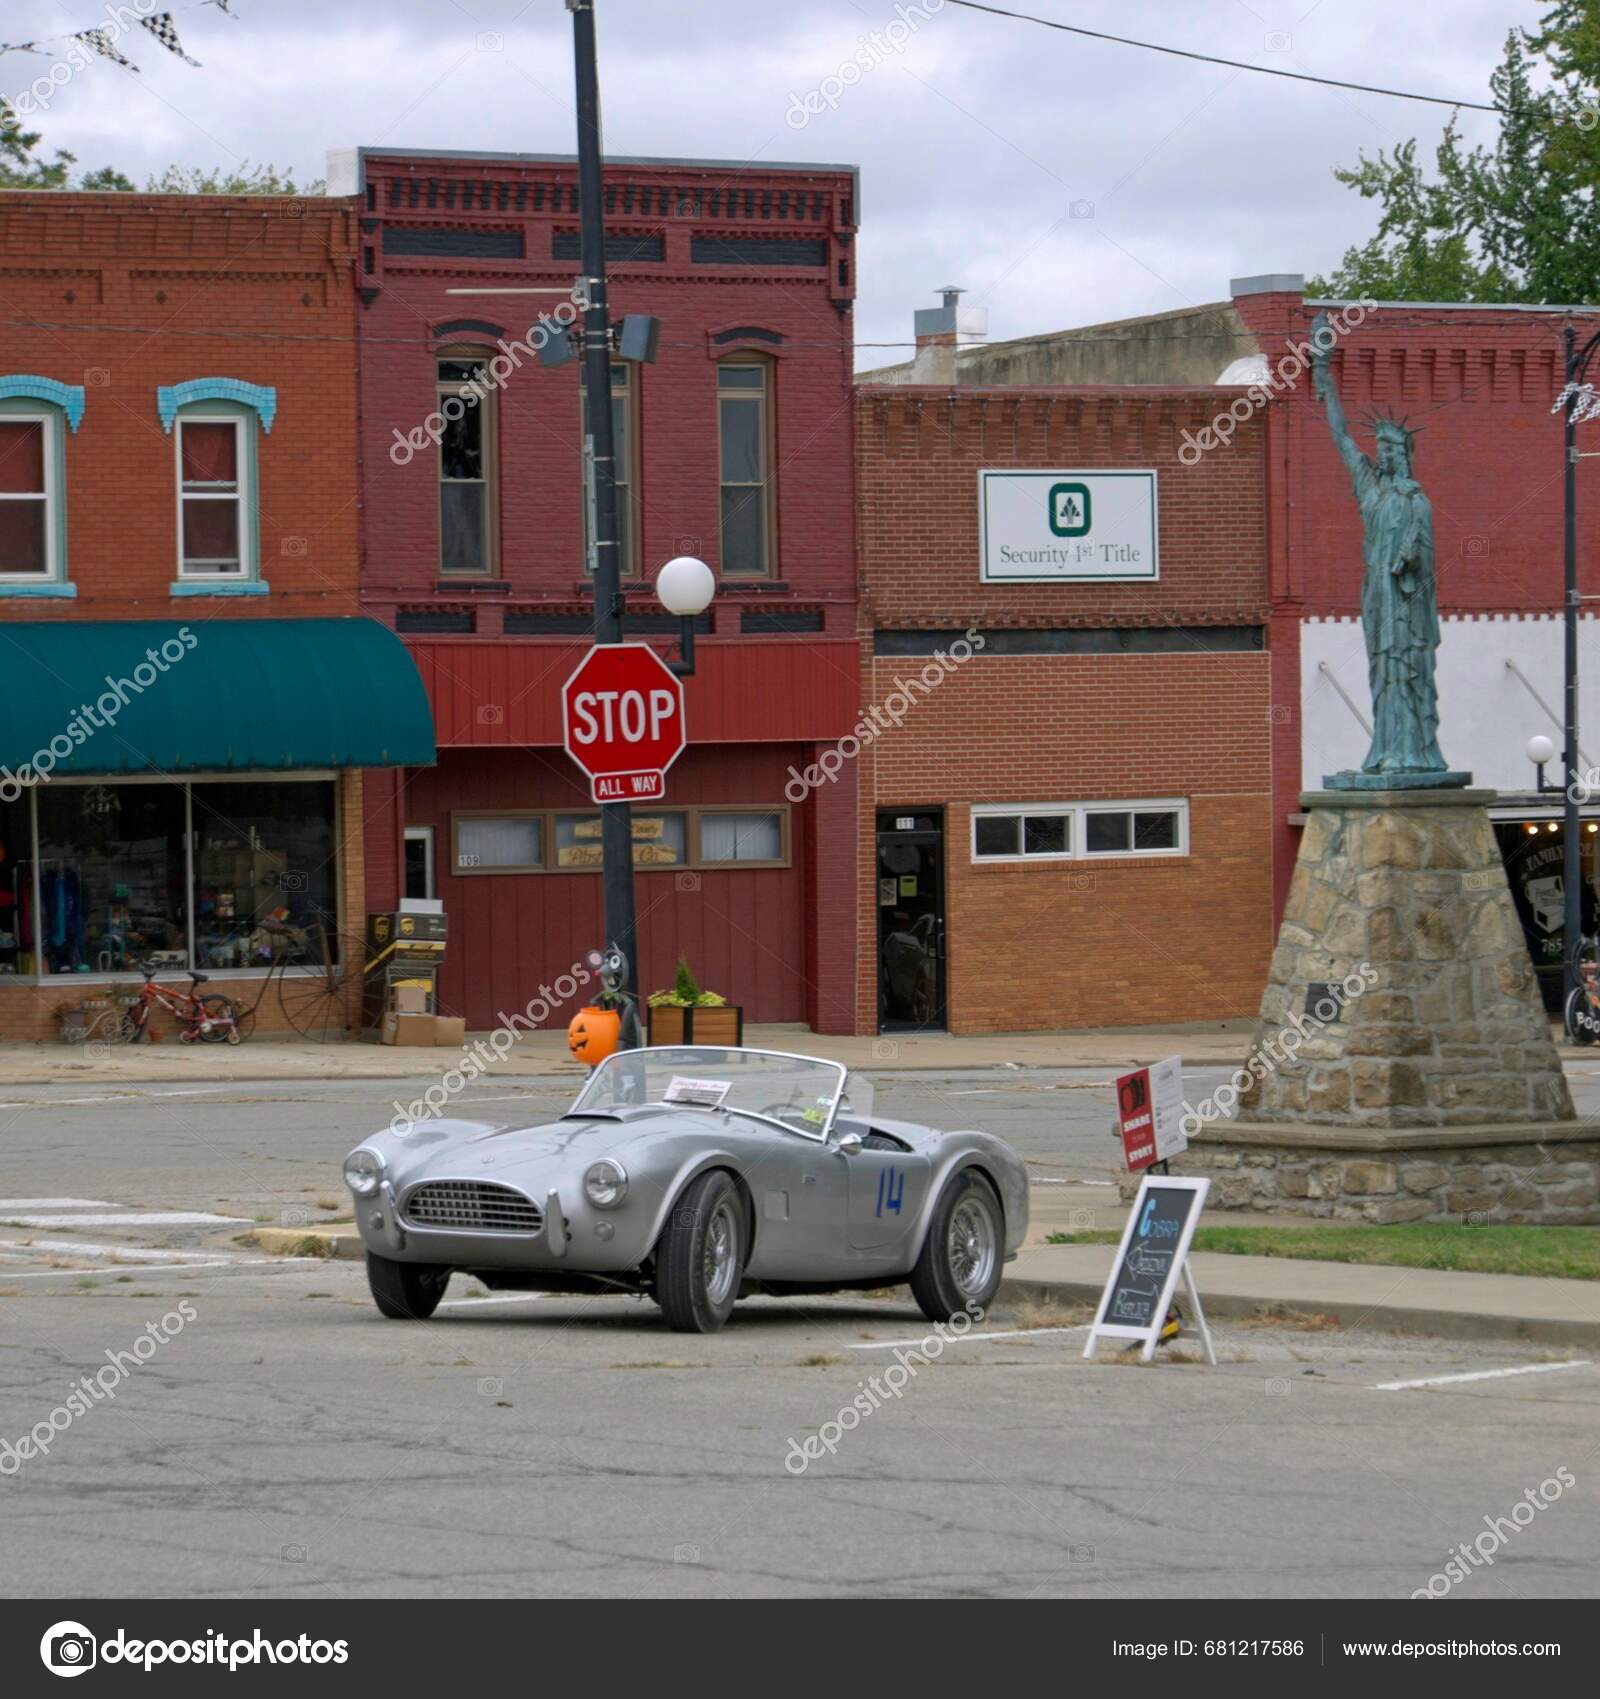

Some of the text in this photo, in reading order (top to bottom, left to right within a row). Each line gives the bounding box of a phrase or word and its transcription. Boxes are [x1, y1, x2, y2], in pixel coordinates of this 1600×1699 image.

[1000, 544, 1069, 569] Security
[1099, 543, 1140, 563] Title
[573, 689, 675, 745] STOP
[599, 775, 657, 796] ALL WAY
[898, 817, 913, 829] 111
[460, 856, 479, 866] 109
[1124, 1113, 1151, 1132] SHARE
[1128, 1144, 1153, 1163] STORY
[876, 1166, 904, 1218] 14
